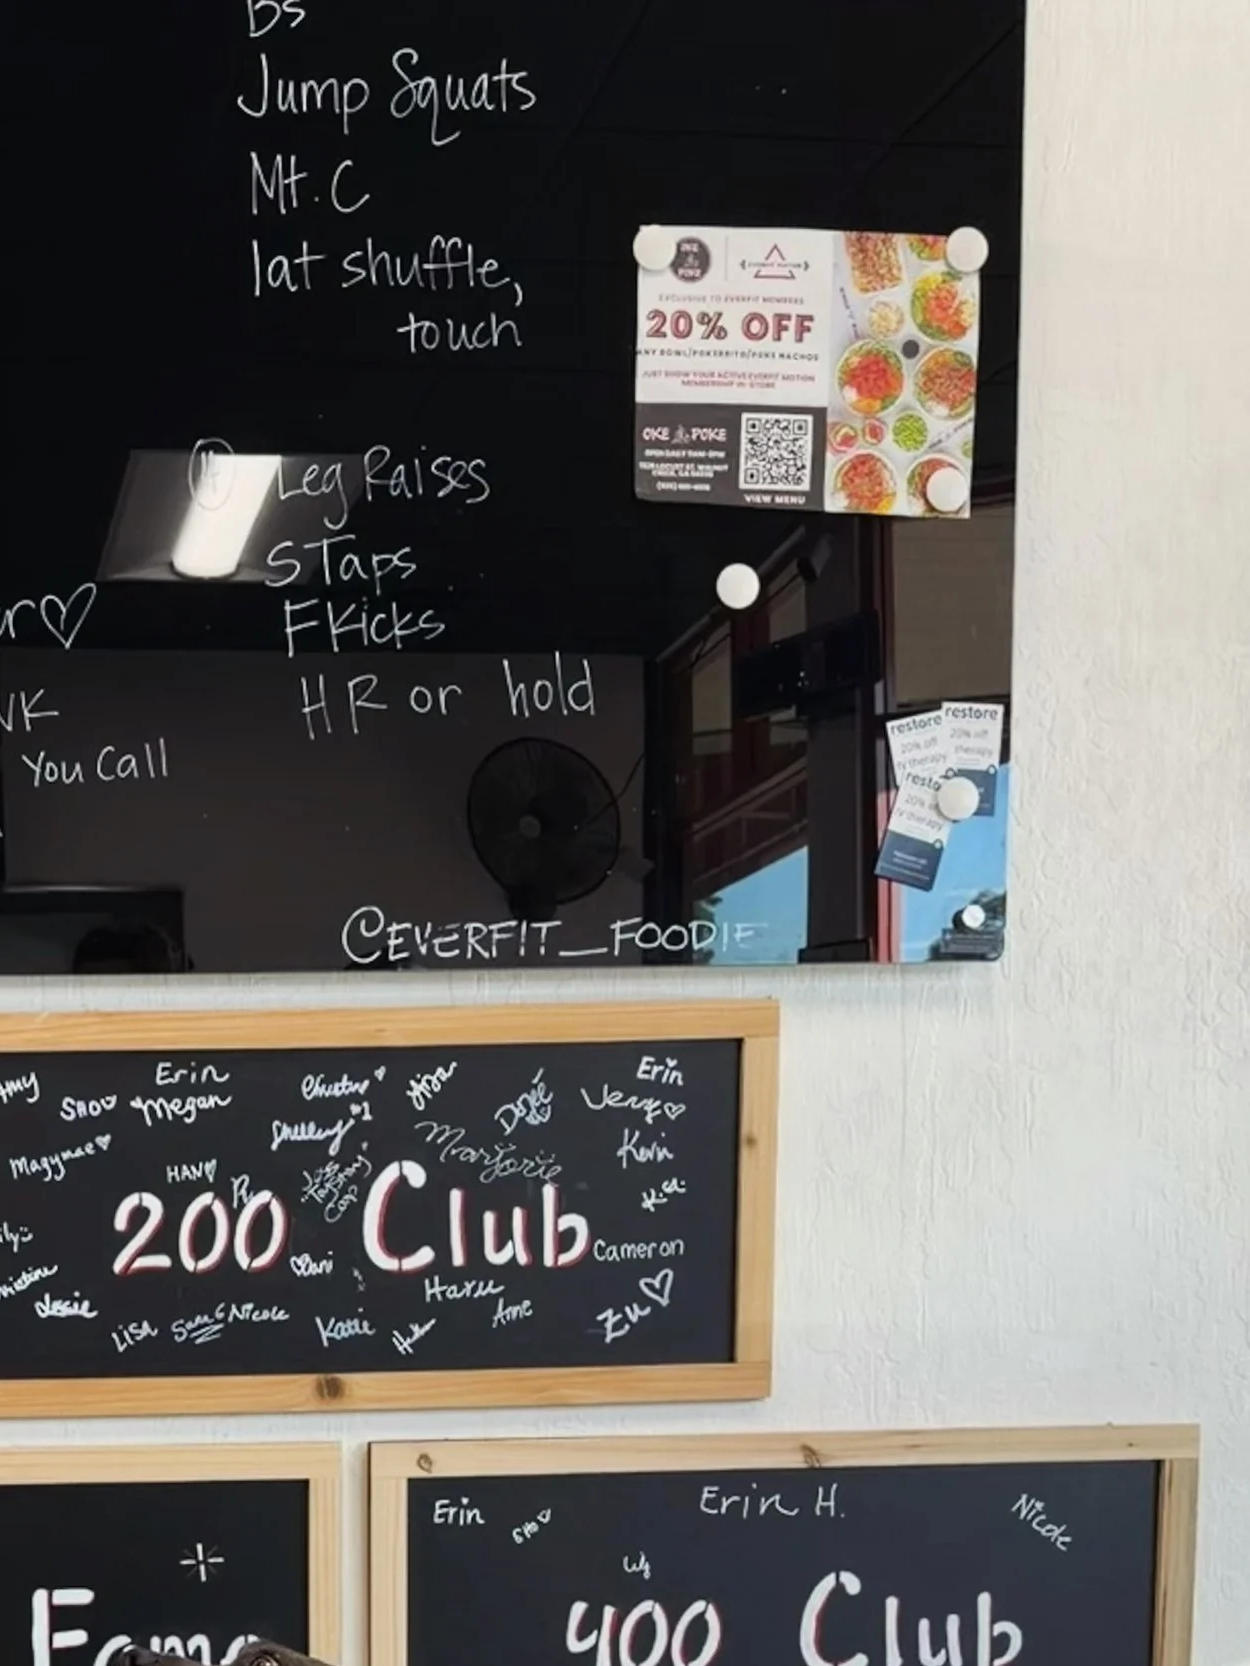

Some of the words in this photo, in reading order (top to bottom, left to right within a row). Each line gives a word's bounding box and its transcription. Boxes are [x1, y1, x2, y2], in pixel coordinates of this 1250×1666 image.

[237, 53, 369, 134] Jump
[390, 47, 537, 146] Squats
[251, 239, 328, 297] lat
[341, 234, 523, 307] shuffle,
[397, 312, 521, 353] touch
[645, 309, 728, 340] 20%
[741, 312, 814, 343] OFF
[642, 427, 670, 441] OKE
[691, 427, 727, 442] POKE
[275, 456, 348, 529] Leg
[364, 445, 491, 503] Raises
[744, 493, 772, 504] VIEW
[775, 494, 806, 505] MENU
[410, 684, 462, 715] or
[503, 651, 596, 719] hold
[890, 714, 942, 735] restore
[945, 705, 998, 721] restore
[22, 750, 83, 788] You
[96, 738, 168, 780] Call
[906, 772, 941, 792] resto
[155, 1062, 230, 1085] Erin
[636, 1055, 684, 1086] Erin
[112, 1189, 287, 1277] 200
[362, 1159, 591, 1274] Club
[593, 1238, 685, 1262] Cameron
[433, 1497, 485, 1526] Erin
[700, 1483, 799, 1518] Erin
[814, 1484, 845, 1518] H.
